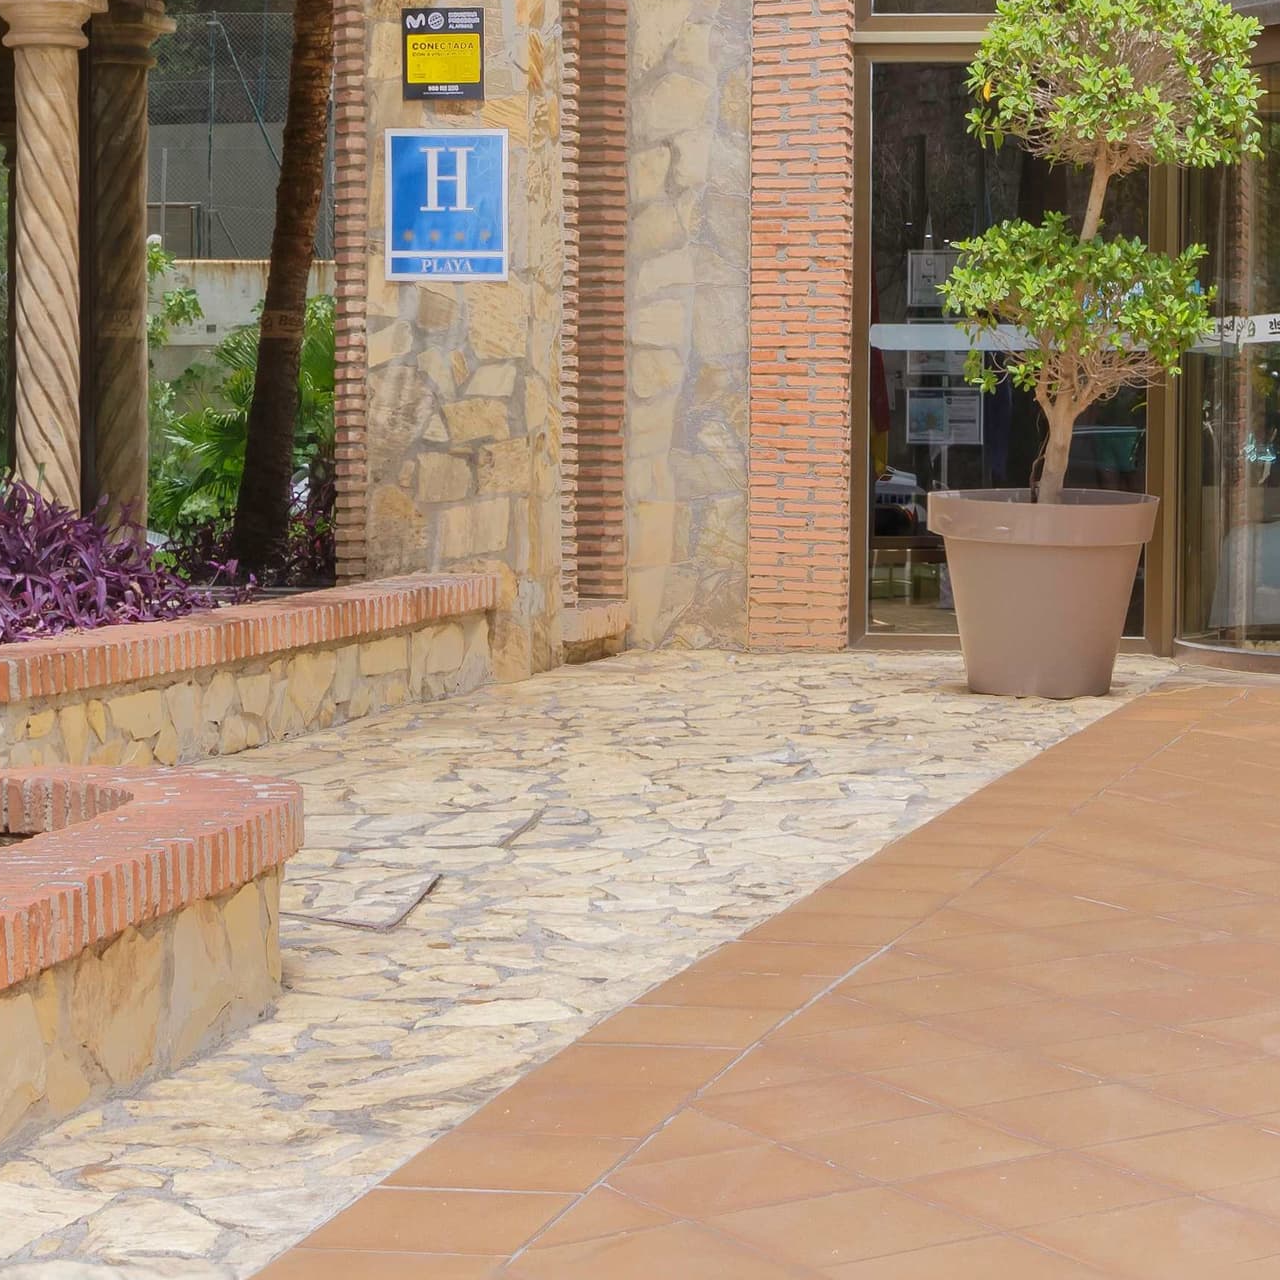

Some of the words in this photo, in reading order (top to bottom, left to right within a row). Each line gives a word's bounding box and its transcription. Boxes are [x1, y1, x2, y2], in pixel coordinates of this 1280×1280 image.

[412, 42, 474, 50] CONECTADA
[418, 146, 475, 212] H
[420, 258, 473, 273] PLAYA
